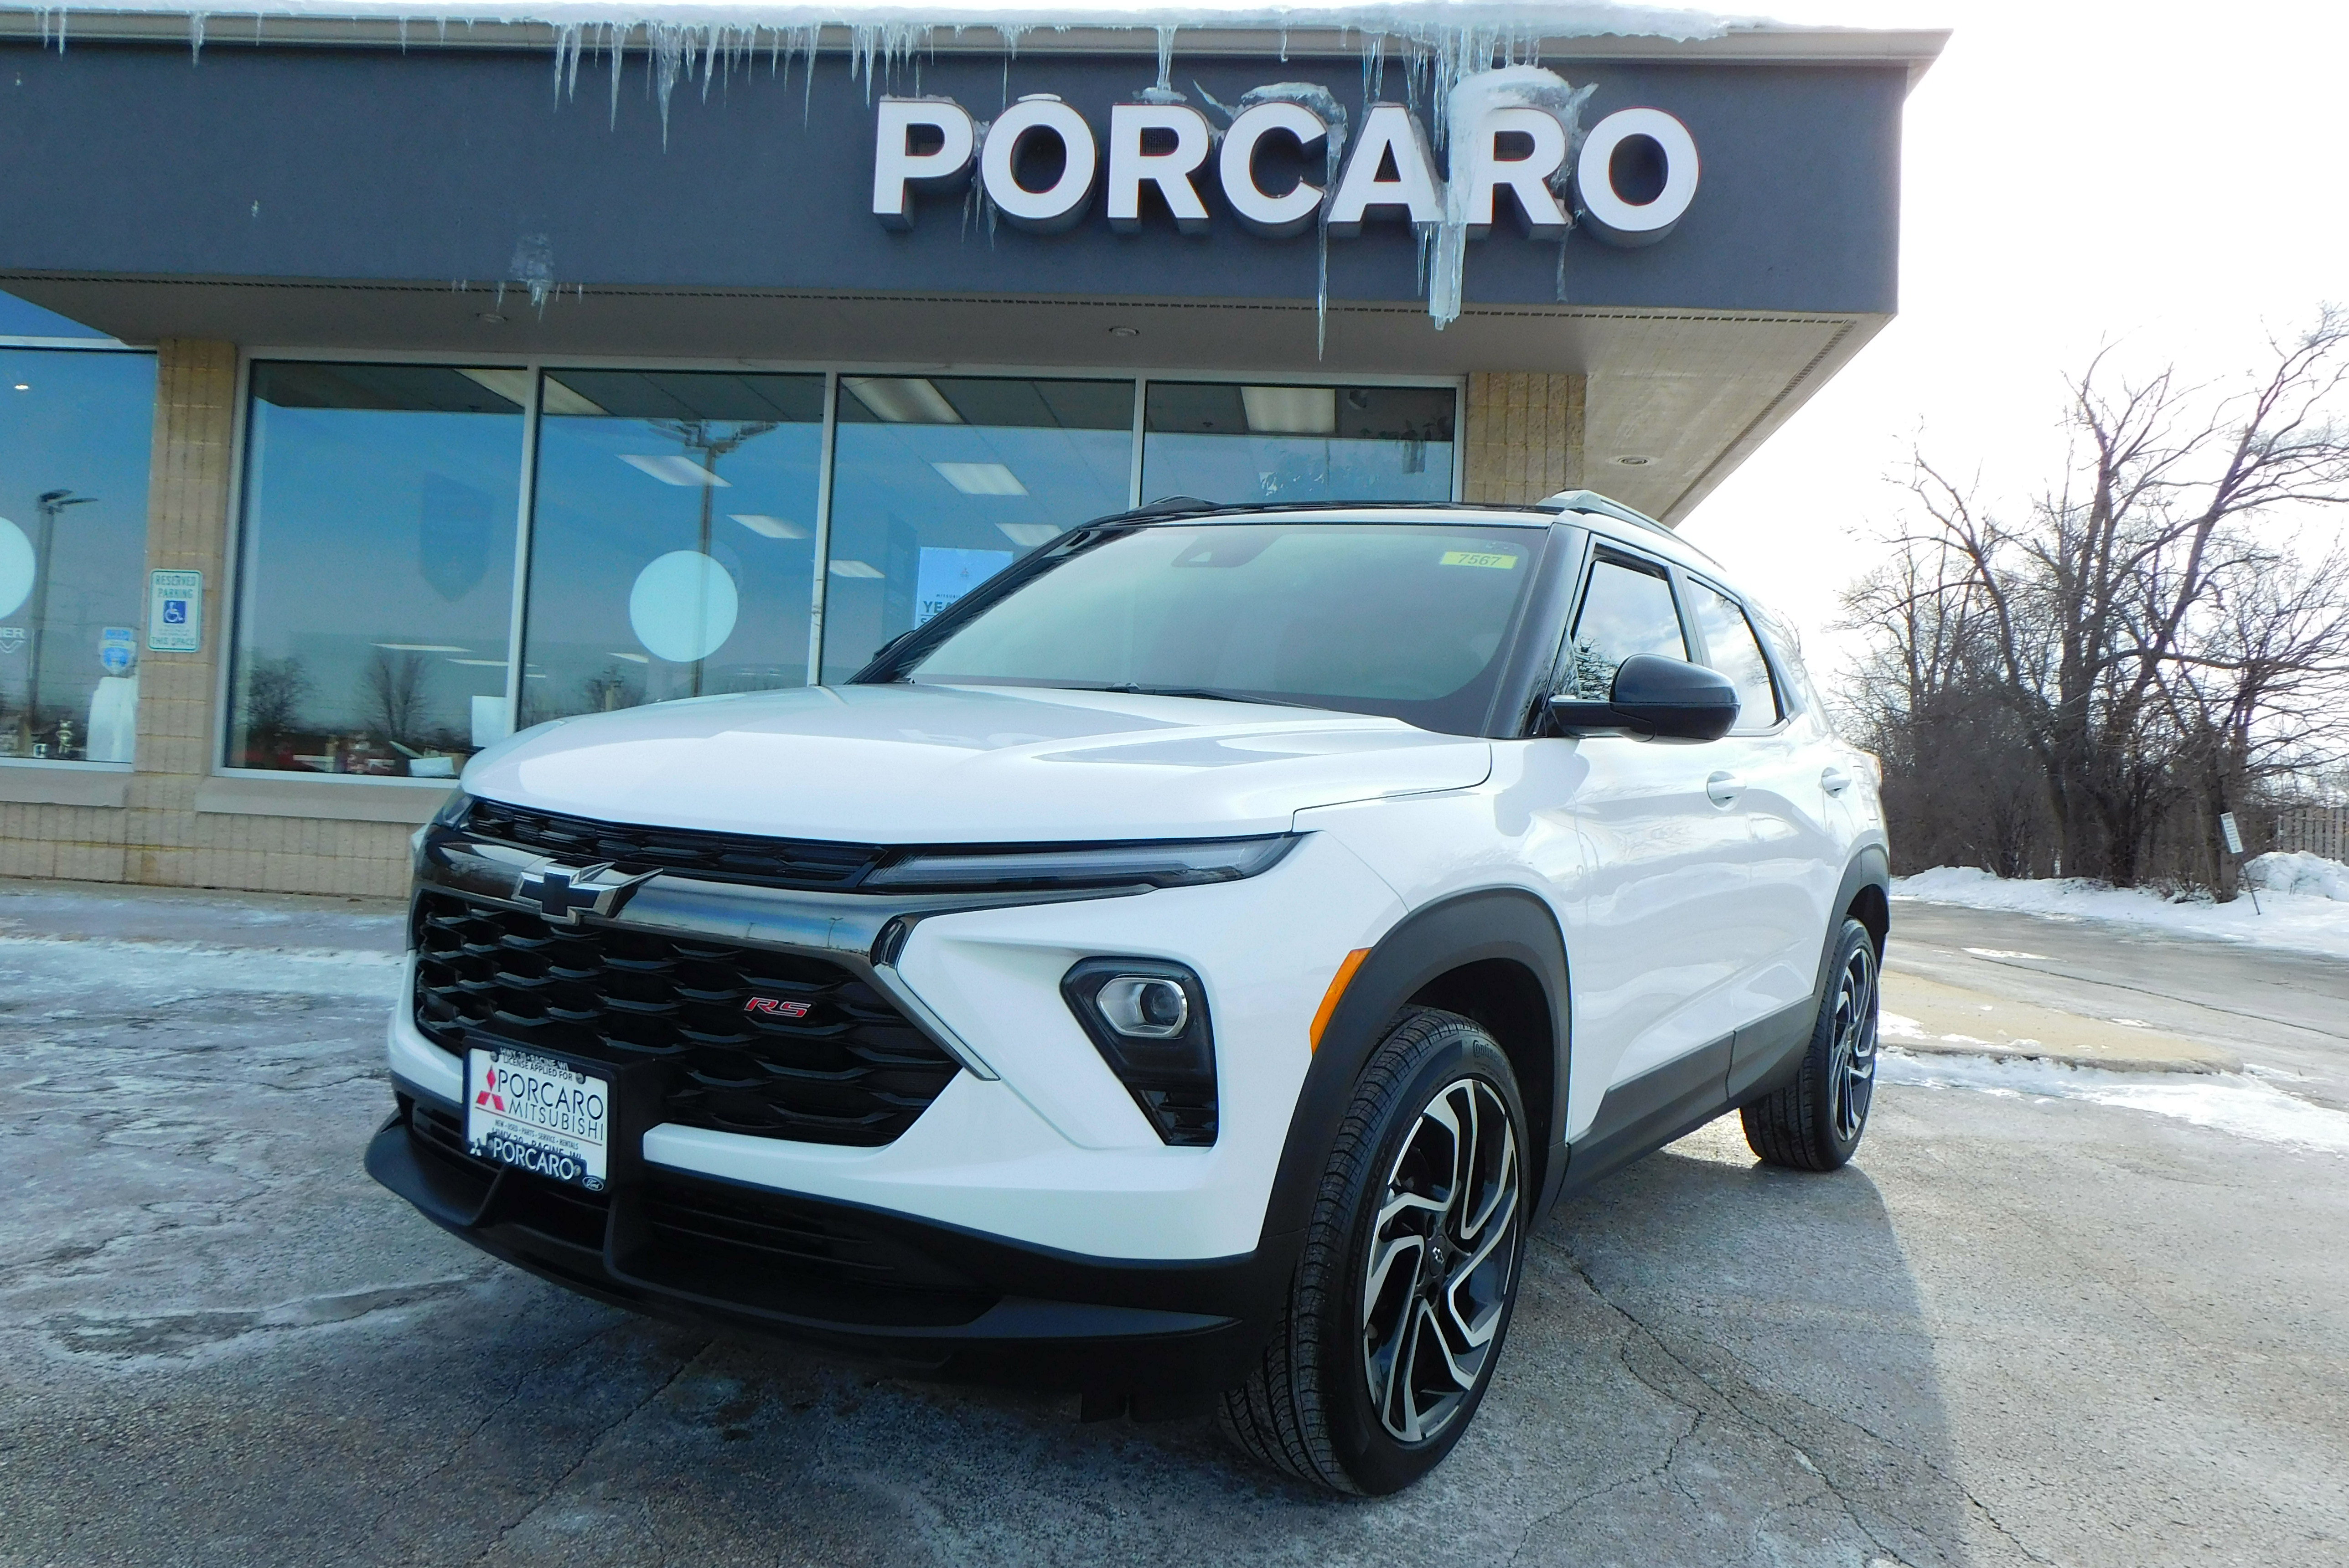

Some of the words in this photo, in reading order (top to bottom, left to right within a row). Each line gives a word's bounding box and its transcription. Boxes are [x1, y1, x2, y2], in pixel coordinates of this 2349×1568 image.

[872, 97, 1701, 234] PORCARO
[1457, 554, 1502, 566] 7567
[155, 575, 196, 586] RESERVED
[157, 588, 193, 598] PARKING
[744, 997, 812, 1018] RS
[503, 1055, 529, 1070] LICENSE
[530, 1063, 558, 1078] APPLIED
[559, 1071, 573, 1082] FOR
[497, 1068, 604, 1120] PORCARO
[508, 1099, 604, 1141] MITSUBISHI
[522, 1127, 535, 1137] PARTS
[538, 1132, 556, 1144] SERVICE
[559, 1138, 579, 1150] RENTALS
[493, 1137, 574, 1180] PORCARO
